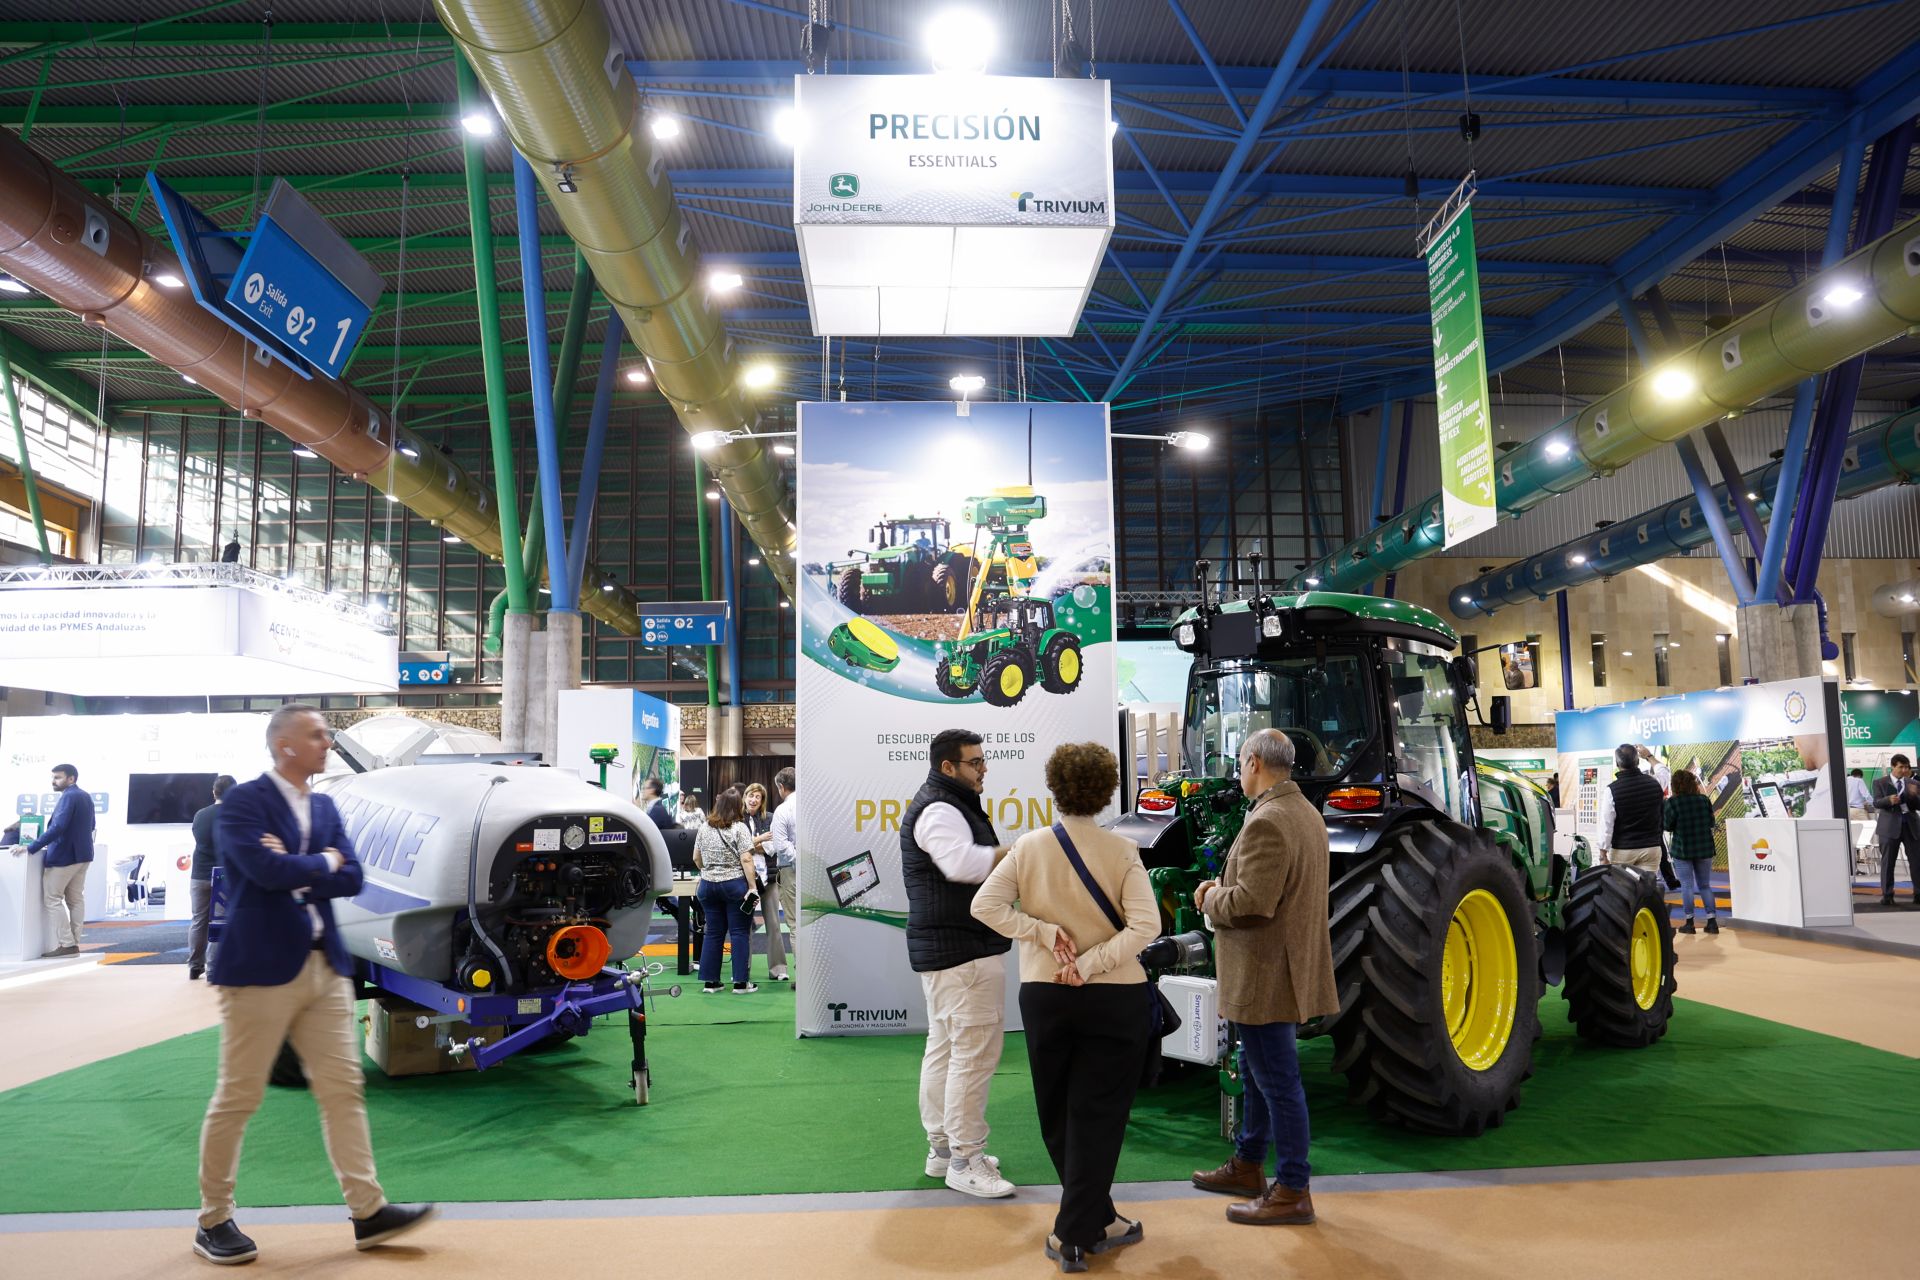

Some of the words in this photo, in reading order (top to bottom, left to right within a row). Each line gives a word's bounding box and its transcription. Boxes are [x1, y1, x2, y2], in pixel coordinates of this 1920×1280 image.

[869, 108, 1041, 141] PRECISIÓN
[909, 155, 998, 168] ESSENTIALS
[1033, 200, 1105, 214] TRIVIUM
[265, 283, 288, 308] Salida
[259, 299, 274, 319] Exit
[298, 316, 316, 346] 2
[328, 317, 352, 366] 1
[1435, 352, 1449, 370] AULA
[31, 610, 81, 621] capacidad
[83, 610, 136, 619] innovadora
[28, 623, 40, 632] de
[42, 623, 57, 632] las
[60, 622, 94, 631] PYMES
[95, 622, 147, 632] Andaluzas
[686, 617, 694, 629] 2
[269, 622, 301, 639] ACENTA
[706, 621, 717, 641] 1
[401, 669, 410, 681] 2
[1628, 709, 1694, 740] Argentina
[996, 732, 1010, 743] DE
[1014, 732, 1035, 743] LOS
[888, 751, 929, 761] ESENCI
[985, 749, 1025, 760] CAMPO
[598, 832, 627, 842] TEYME
[1750, 863, 1776, 873] REPSOL
[848, 1009, 907, 1021] TRIVIUM
